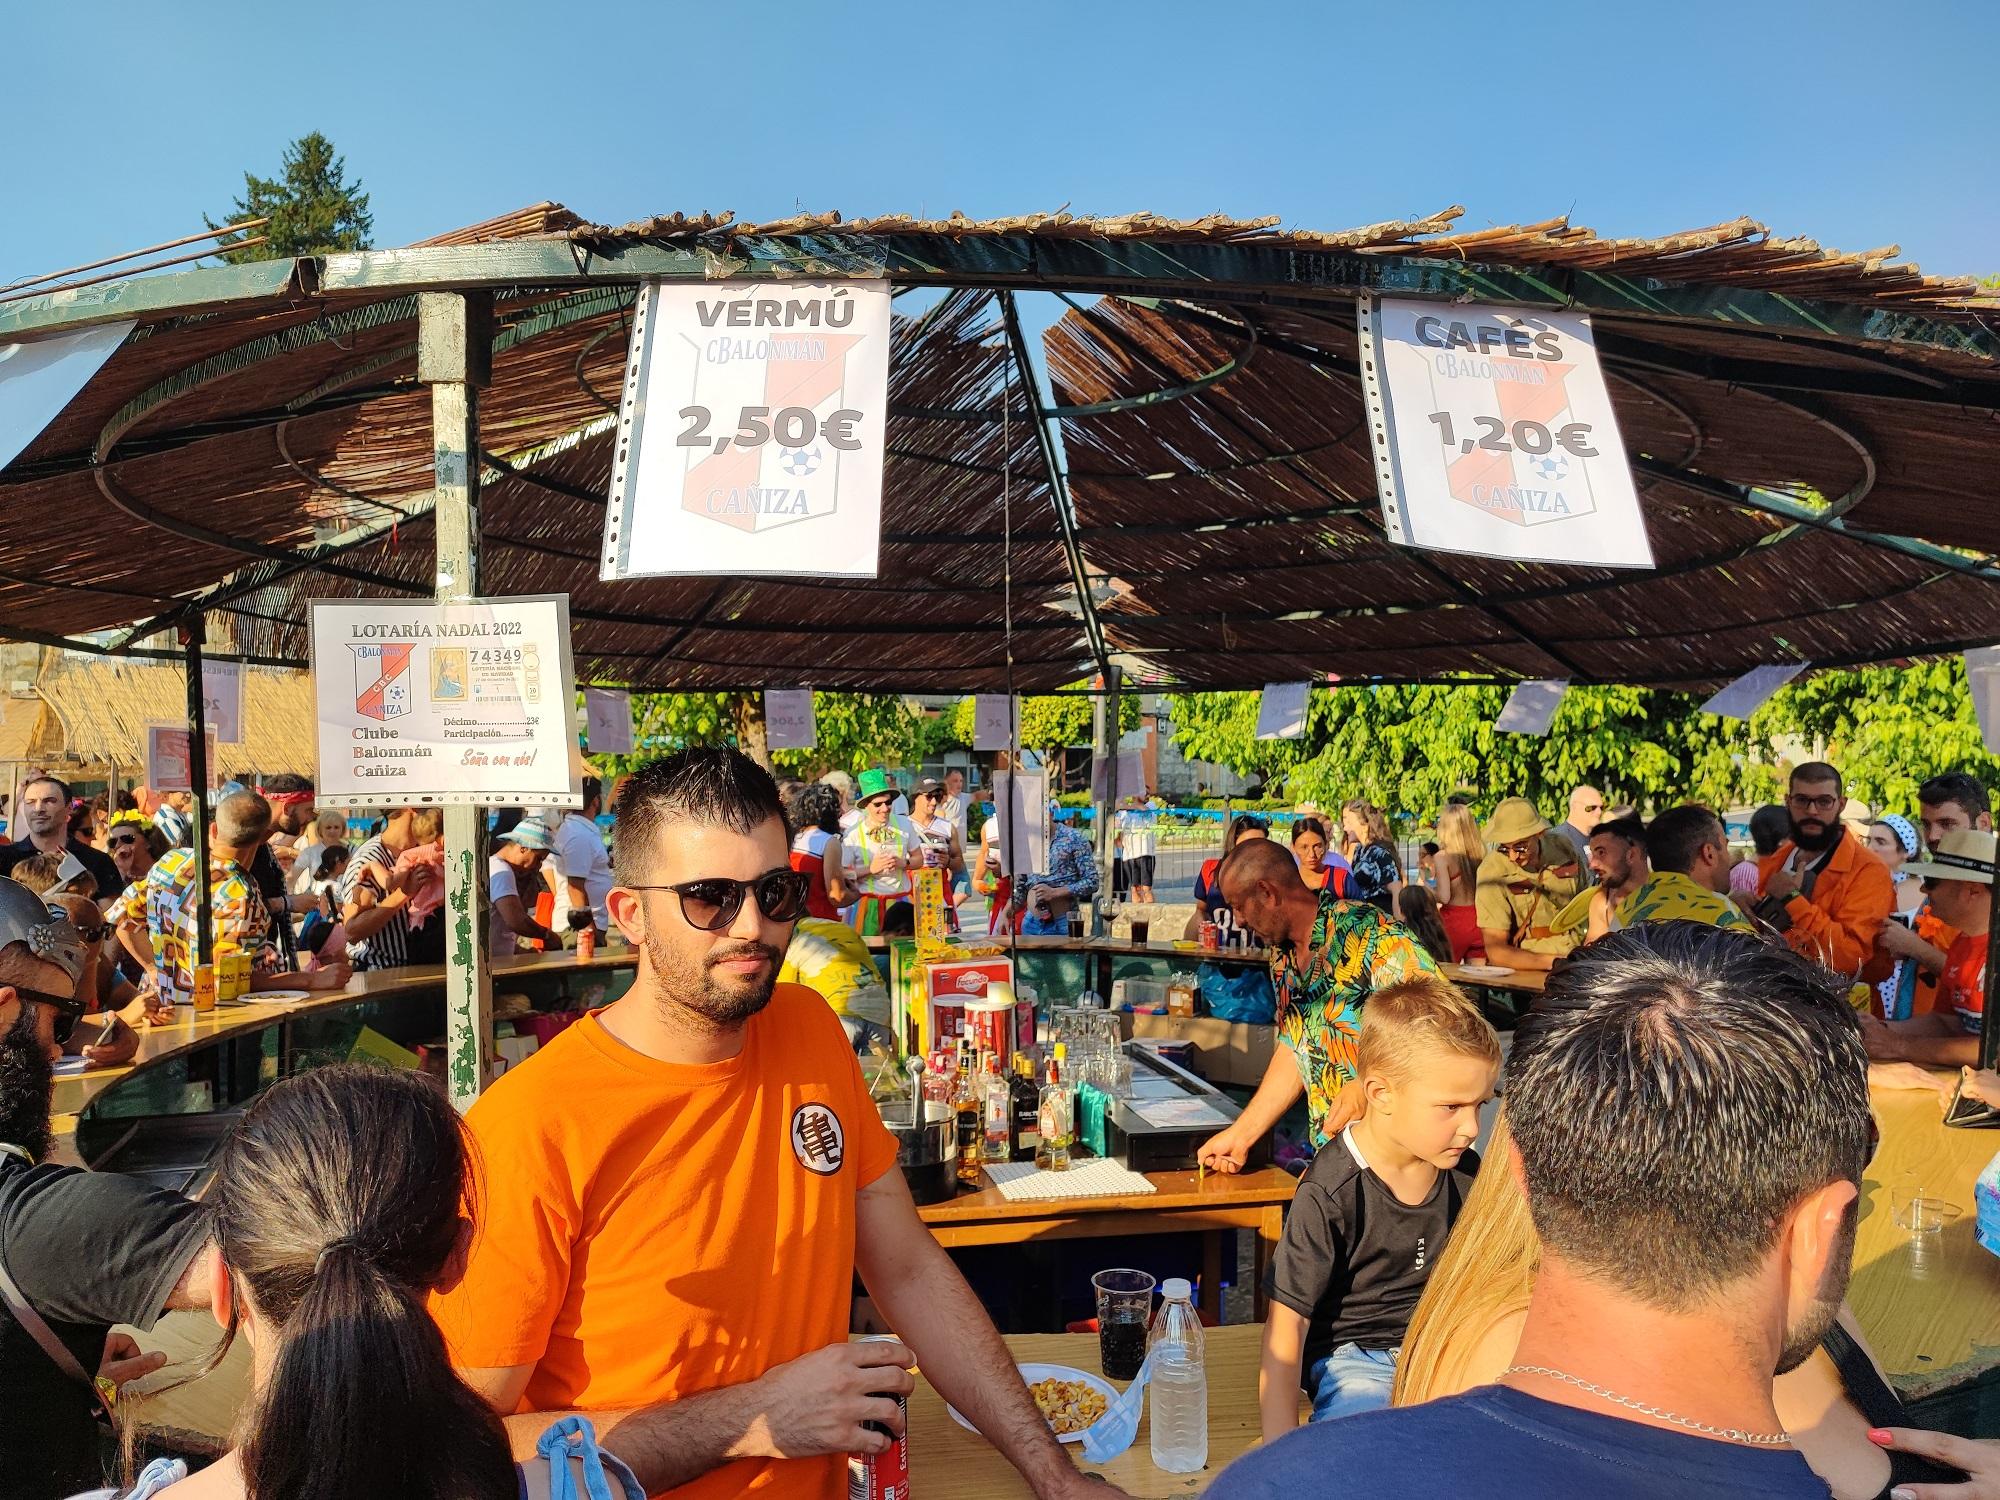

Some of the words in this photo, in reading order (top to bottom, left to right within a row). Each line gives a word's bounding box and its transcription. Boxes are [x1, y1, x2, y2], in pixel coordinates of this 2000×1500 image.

[696, 288, 855, 327] VERMÚ
[1415, 316, 1563, 361] CAFÉS
[676, 405, 863, 455] 2,50€
[1428, 411, 1599, 458] 1,20€
[706, 482, 809, 514] CAÑIZA
[1471, 482, 1571, 514] CAÑIZA
[352, 620, 433, 638] LOTARÍA
[436, 623, 490, 637] NADAL
[493, 621, 522, 635] 2022
[469, 649, 521, 662] 74349
[526, 716, 540, 725] 23€
[352, 727, 399, 739] Clube
[443, 728, 501, 739] Participación
[525, 728, 535, 737] 5€
[352, 744, 433, 758] Balonmán
[353, 764, 408, 777] Cañiza
